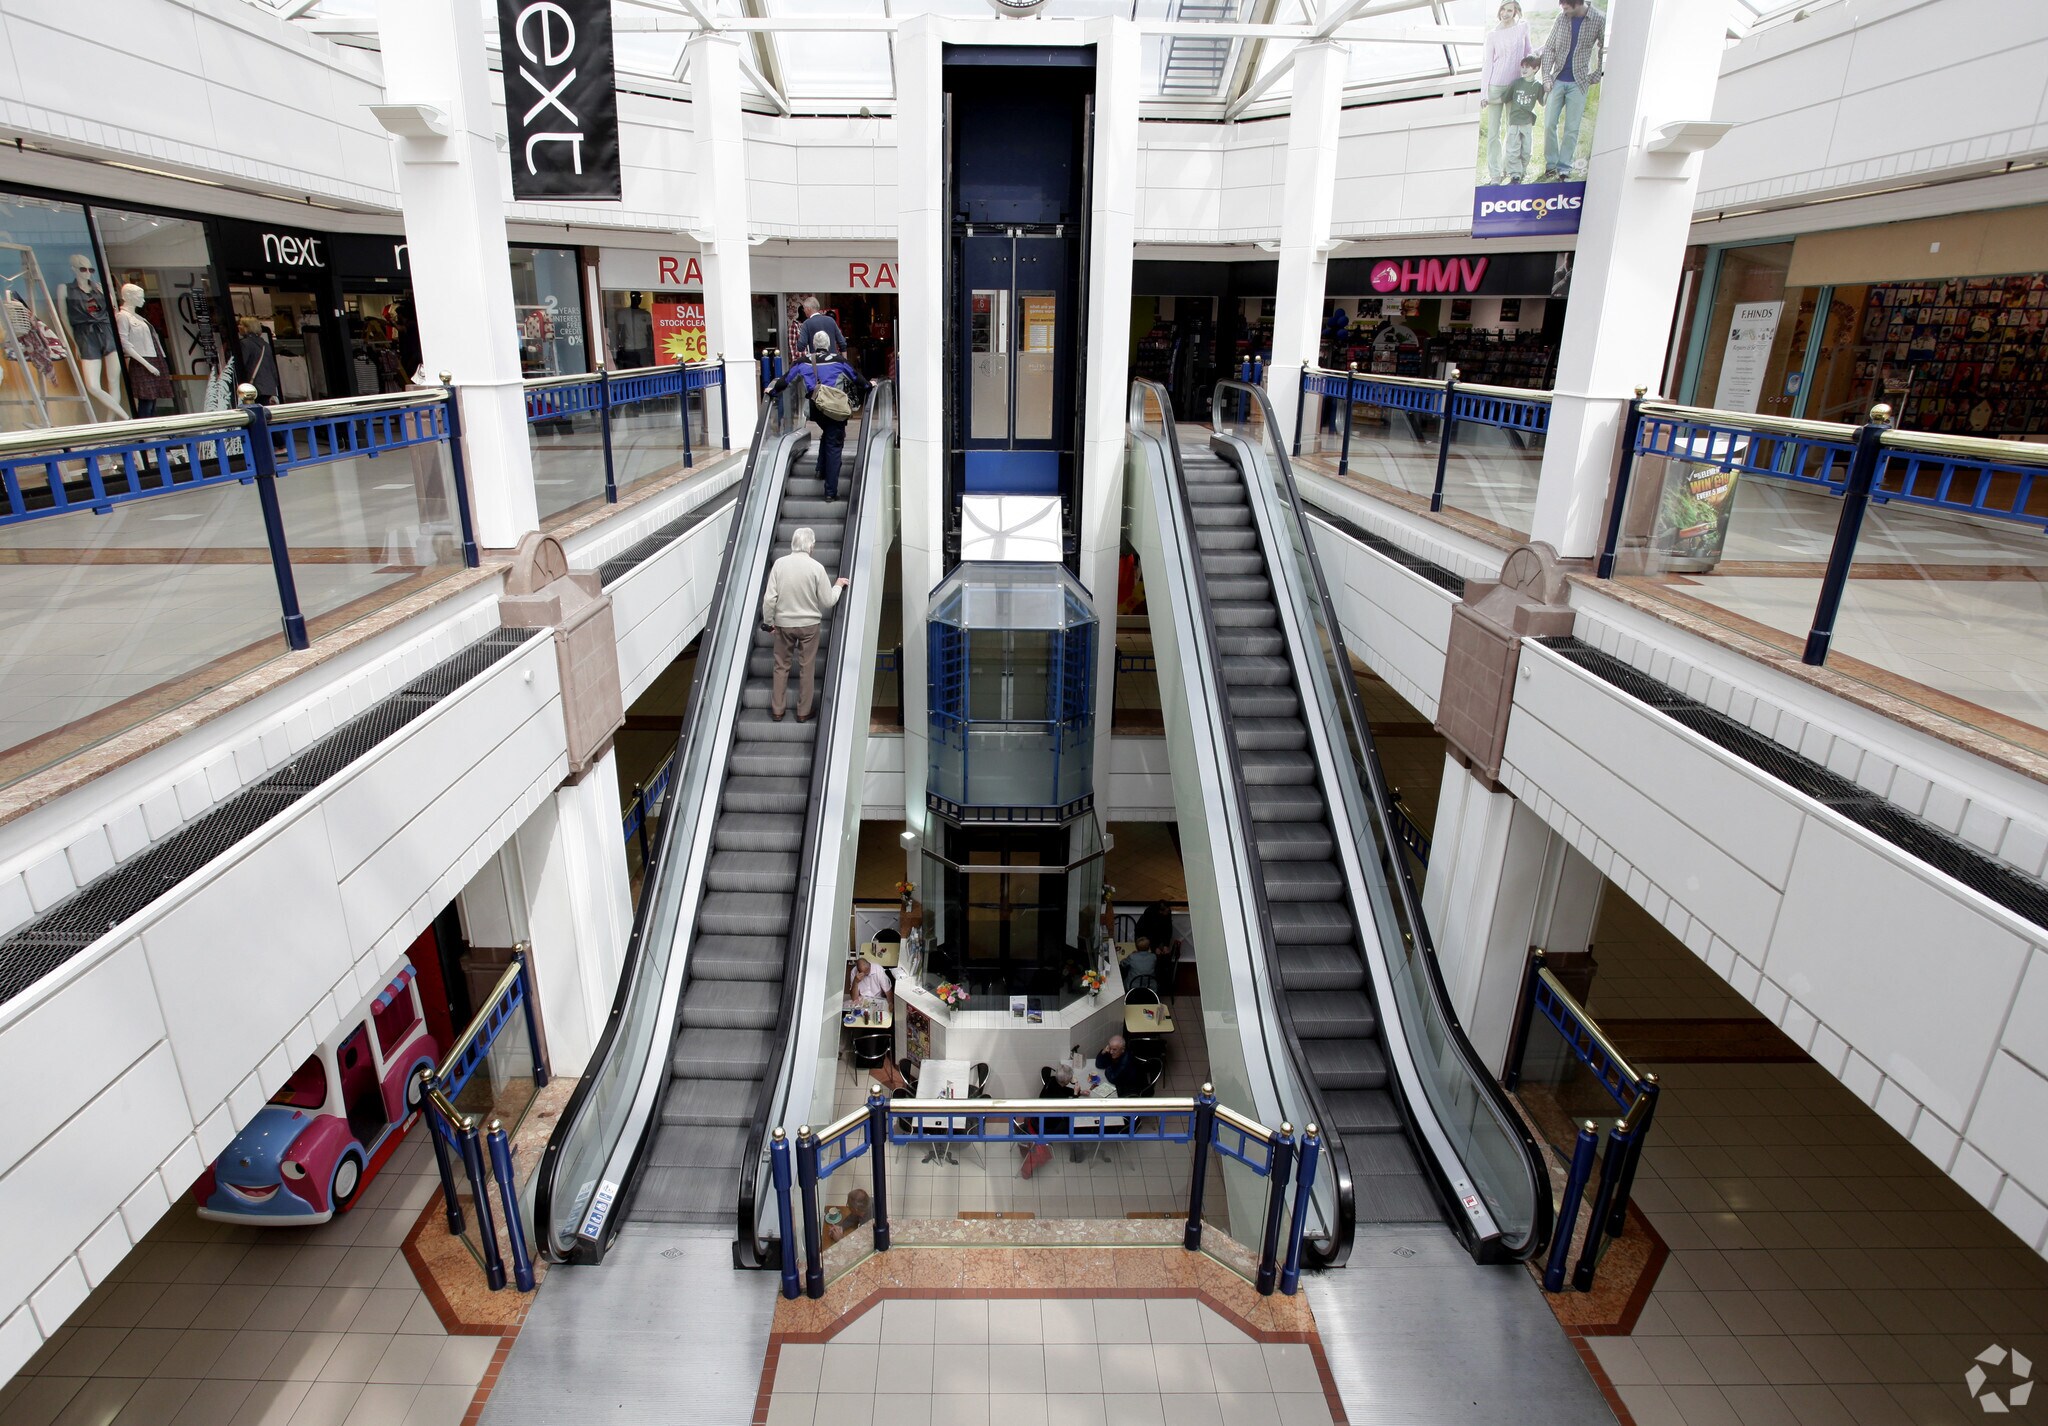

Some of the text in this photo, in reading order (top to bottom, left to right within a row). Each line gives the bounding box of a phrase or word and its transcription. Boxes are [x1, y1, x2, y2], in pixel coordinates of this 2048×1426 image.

[1480, 194, 1582, 218] peacocks
[262, 233, 326, 268] next
[658, 256, 703, 285] RA
[848, 262, 899, 288] RA
[1400, 256, 1489, 293] HMV
[544, 295, 559, 315] 2
[558, 306, 581, 315] YEARS
[1741, 308, 1774, 319] F.HINDS
[552, 315, 582, 323] INTEREST
[659, 319, 685, 327] STOCK
[568, 335, 583, 346] 0%
[685, 334, 708, 356] £6
[1690, 477, 1712, 494] WIN
